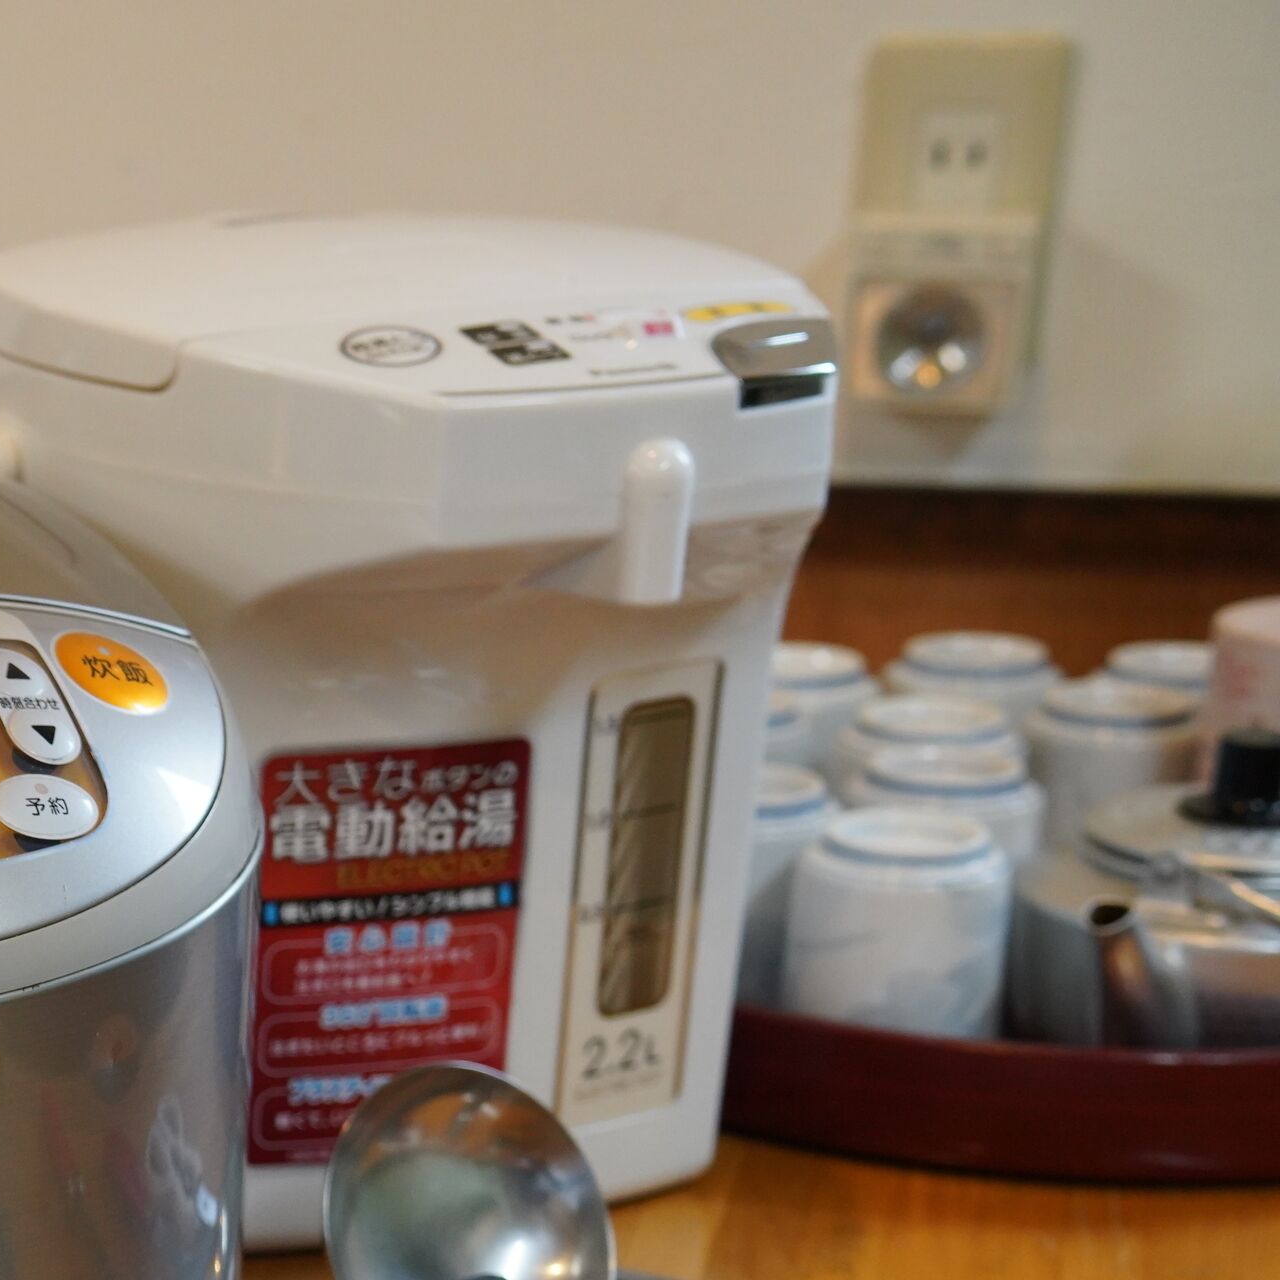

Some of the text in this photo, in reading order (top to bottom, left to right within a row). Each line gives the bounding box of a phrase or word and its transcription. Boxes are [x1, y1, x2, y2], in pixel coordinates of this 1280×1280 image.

[81, 655, 153, 687] 炊飯
[25, 796, 69, 816] 予約
[269, 787, 516, 862] 電動給湯
